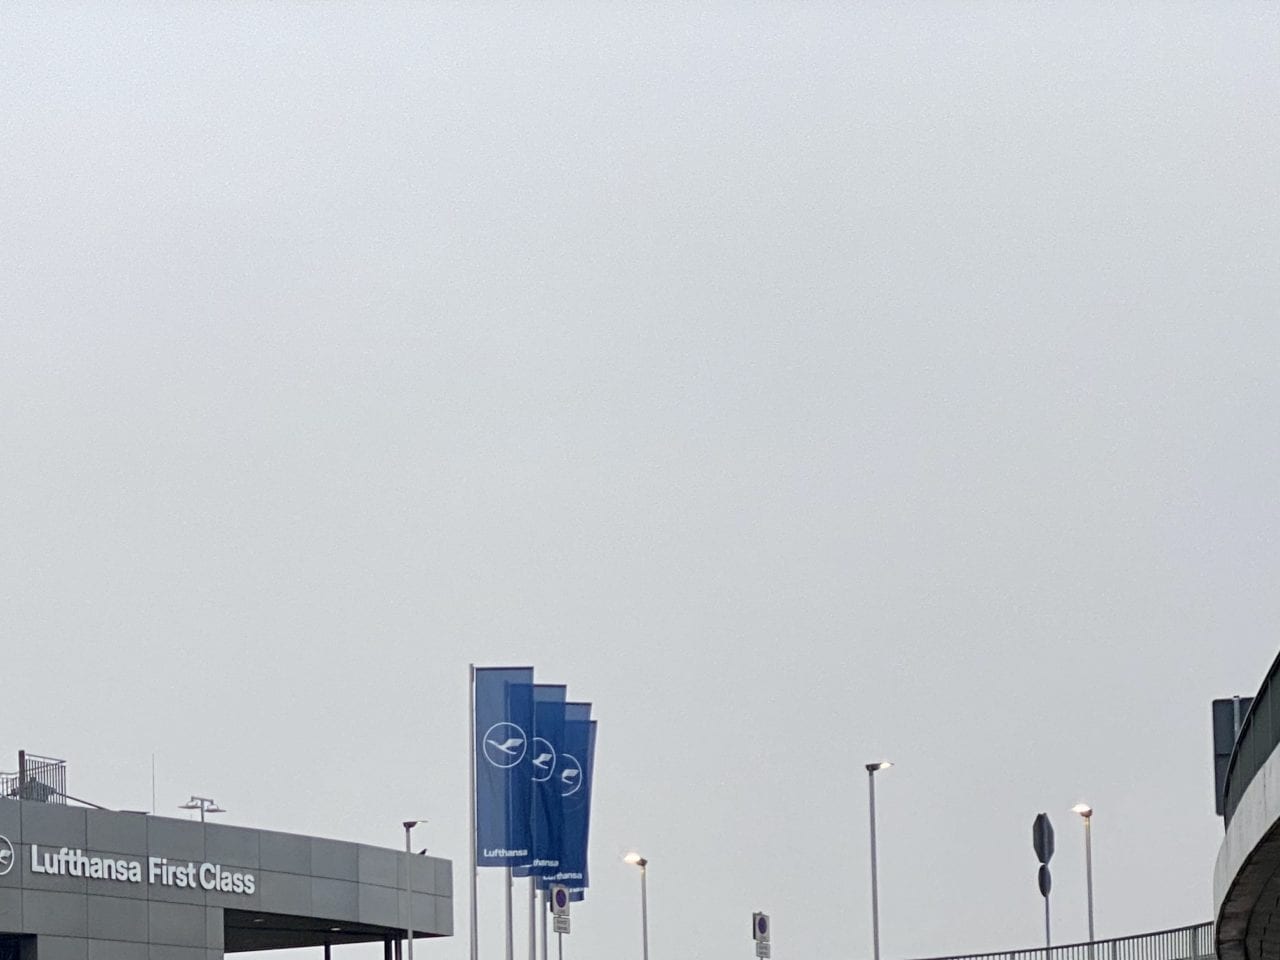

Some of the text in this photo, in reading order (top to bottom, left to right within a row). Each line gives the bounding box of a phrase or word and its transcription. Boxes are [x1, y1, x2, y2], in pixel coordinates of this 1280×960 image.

[483, 848, 528, 857] Lufthansa
[533, 859, 559, 867] thansa
[31, 844, 256, 895] Lufthansa First Class
